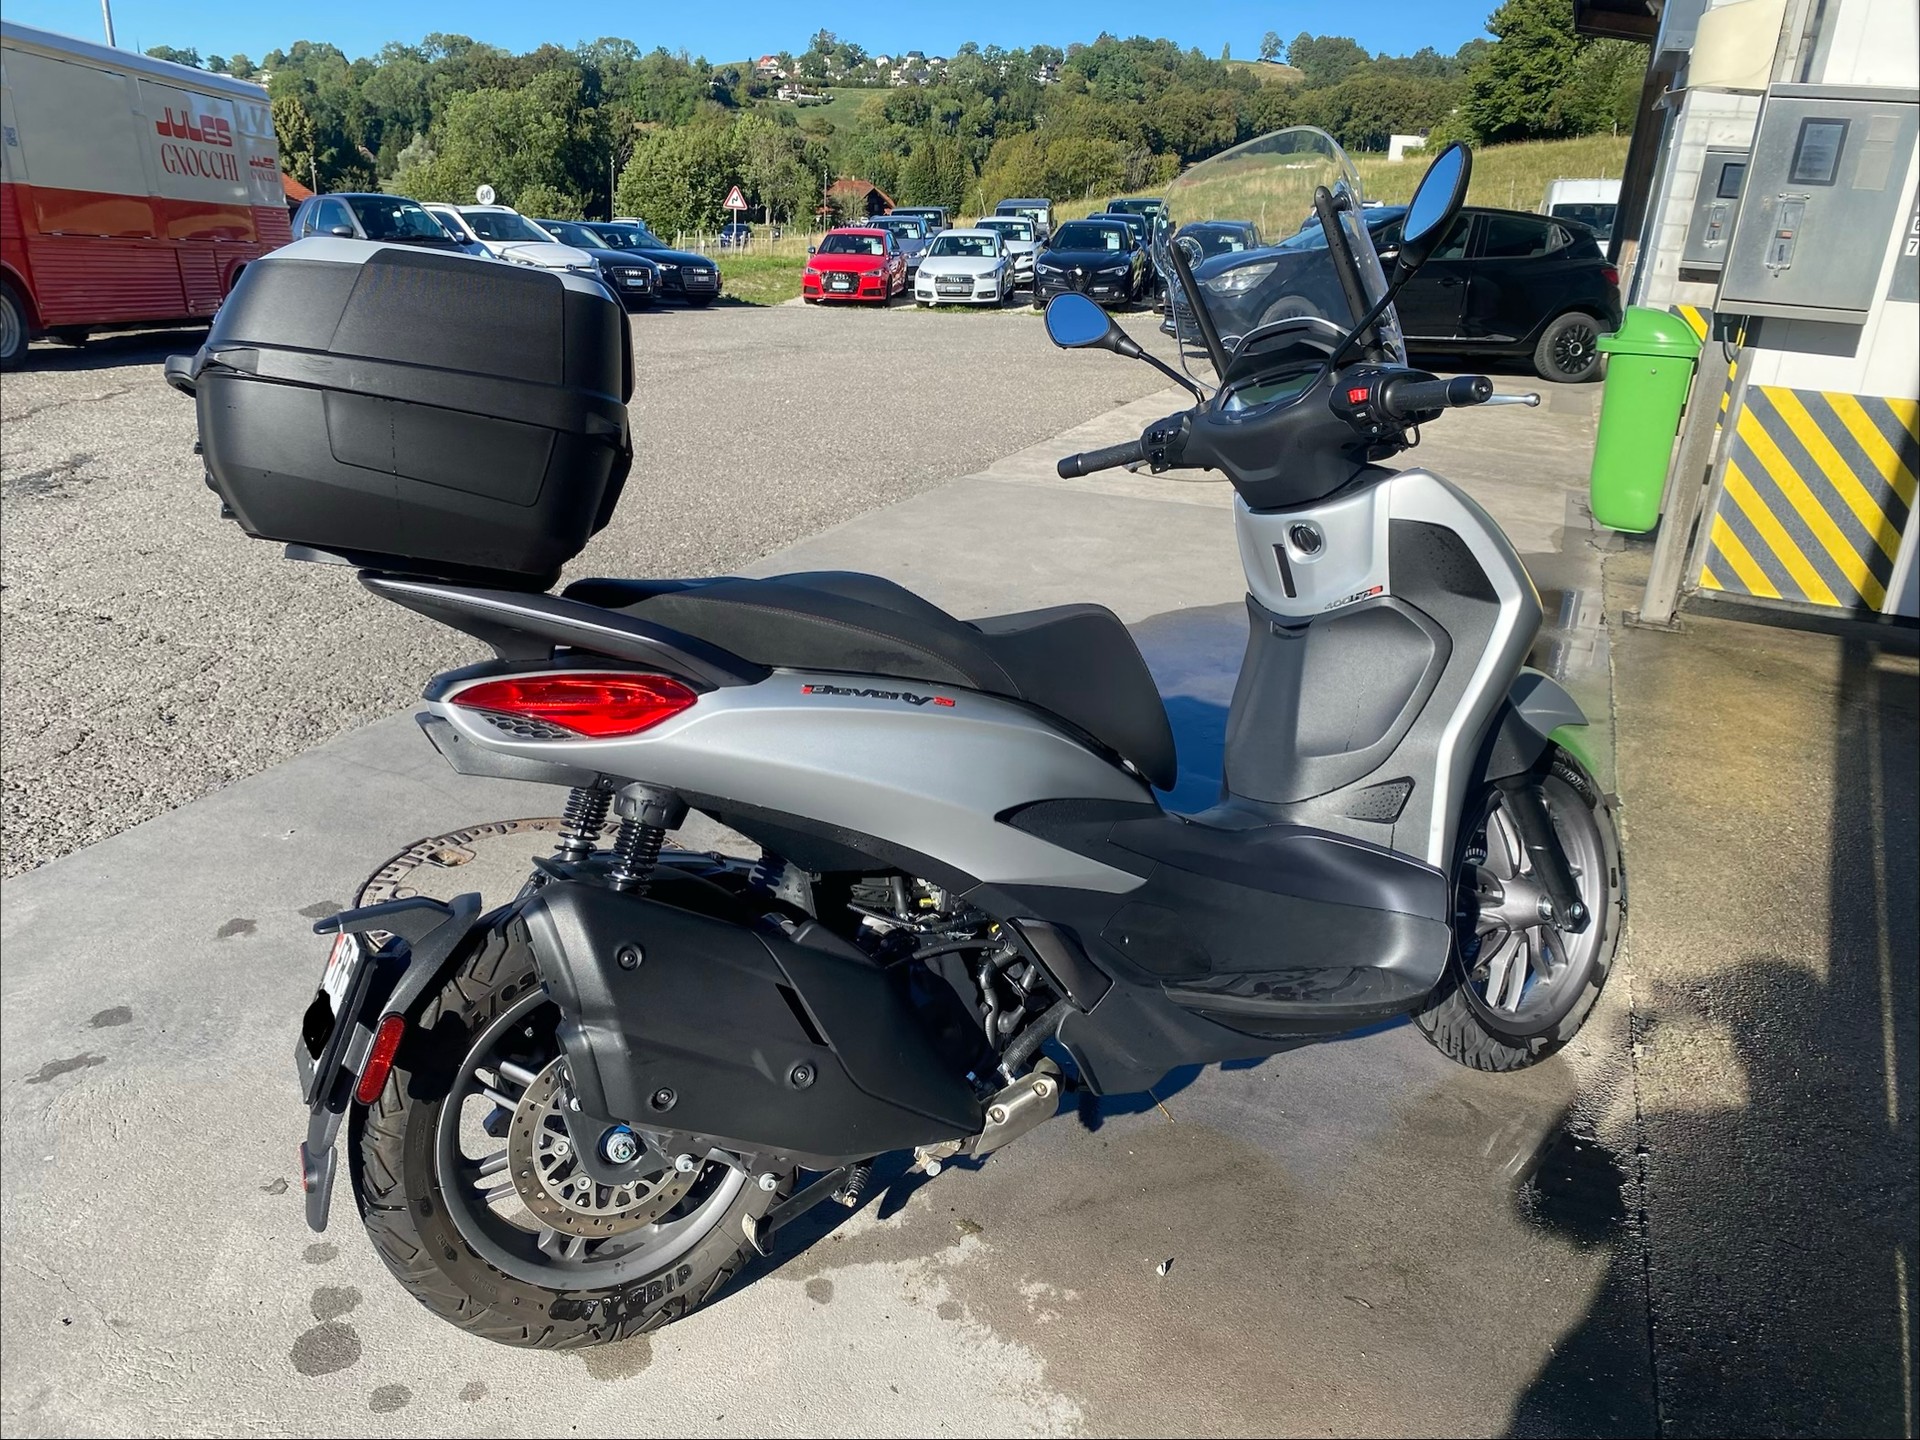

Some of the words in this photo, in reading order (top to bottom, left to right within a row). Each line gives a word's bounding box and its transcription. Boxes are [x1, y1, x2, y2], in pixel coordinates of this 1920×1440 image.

[156, 106, 233, 147] JULES
[161, 142, 240, 181] GNOCCHI
[1909, 241, 1918, 253] 7
